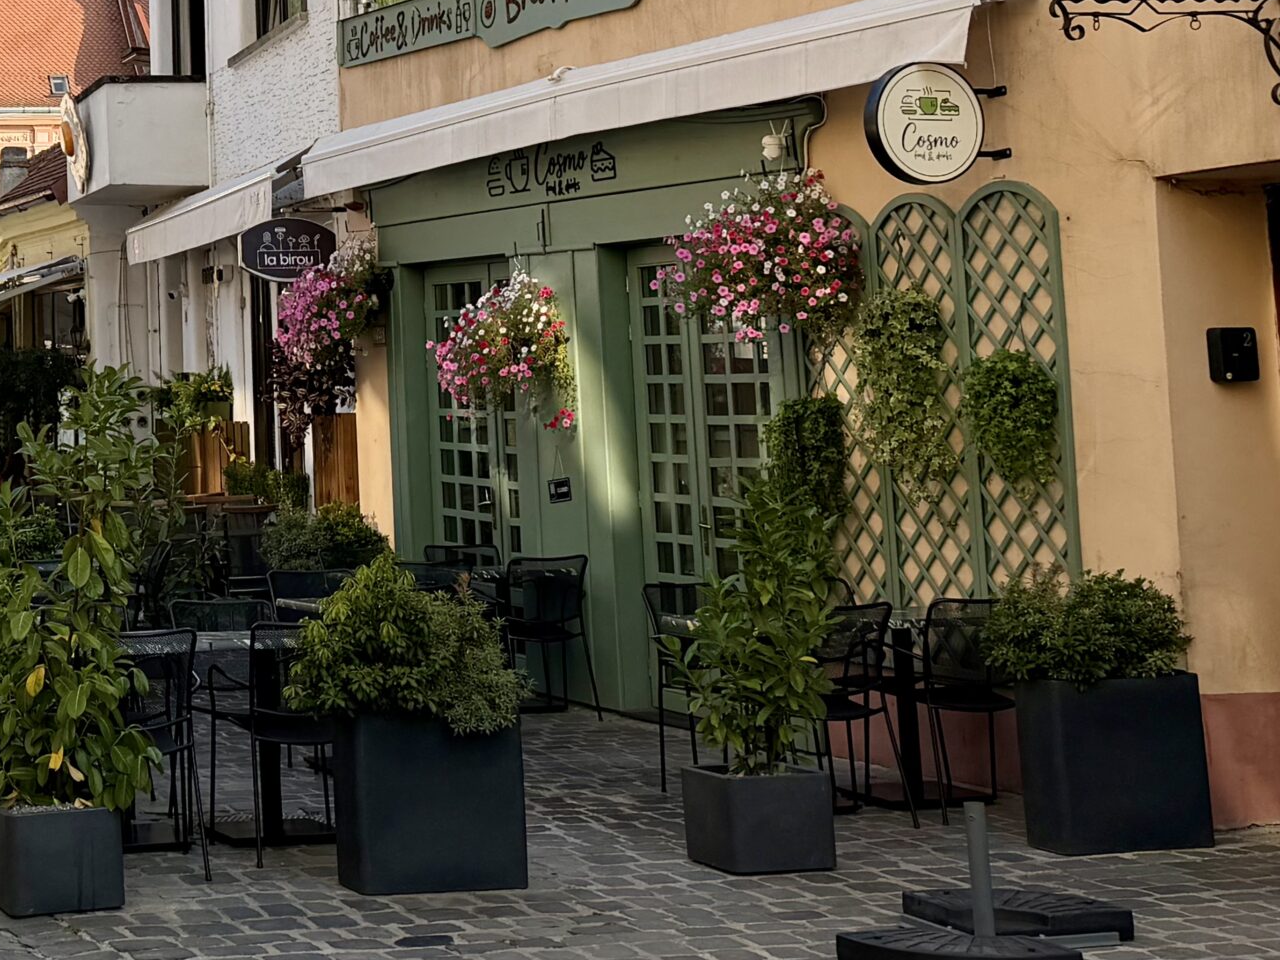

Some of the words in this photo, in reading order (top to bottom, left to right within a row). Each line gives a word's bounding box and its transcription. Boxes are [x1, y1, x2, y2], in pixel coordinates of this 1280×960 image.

[360, 14, 396, 58] Coffee
[396, 11, 408, 51] &
[411, 1, 453, 45] Drinks
[901, 122, 961, 153] Cosmo
[534, 143, 588, 186] Cosmo
[264, 253, 277, 266] la
[280, 252, 314, 267] birou
[1243, 331, 1252, 347] 2
